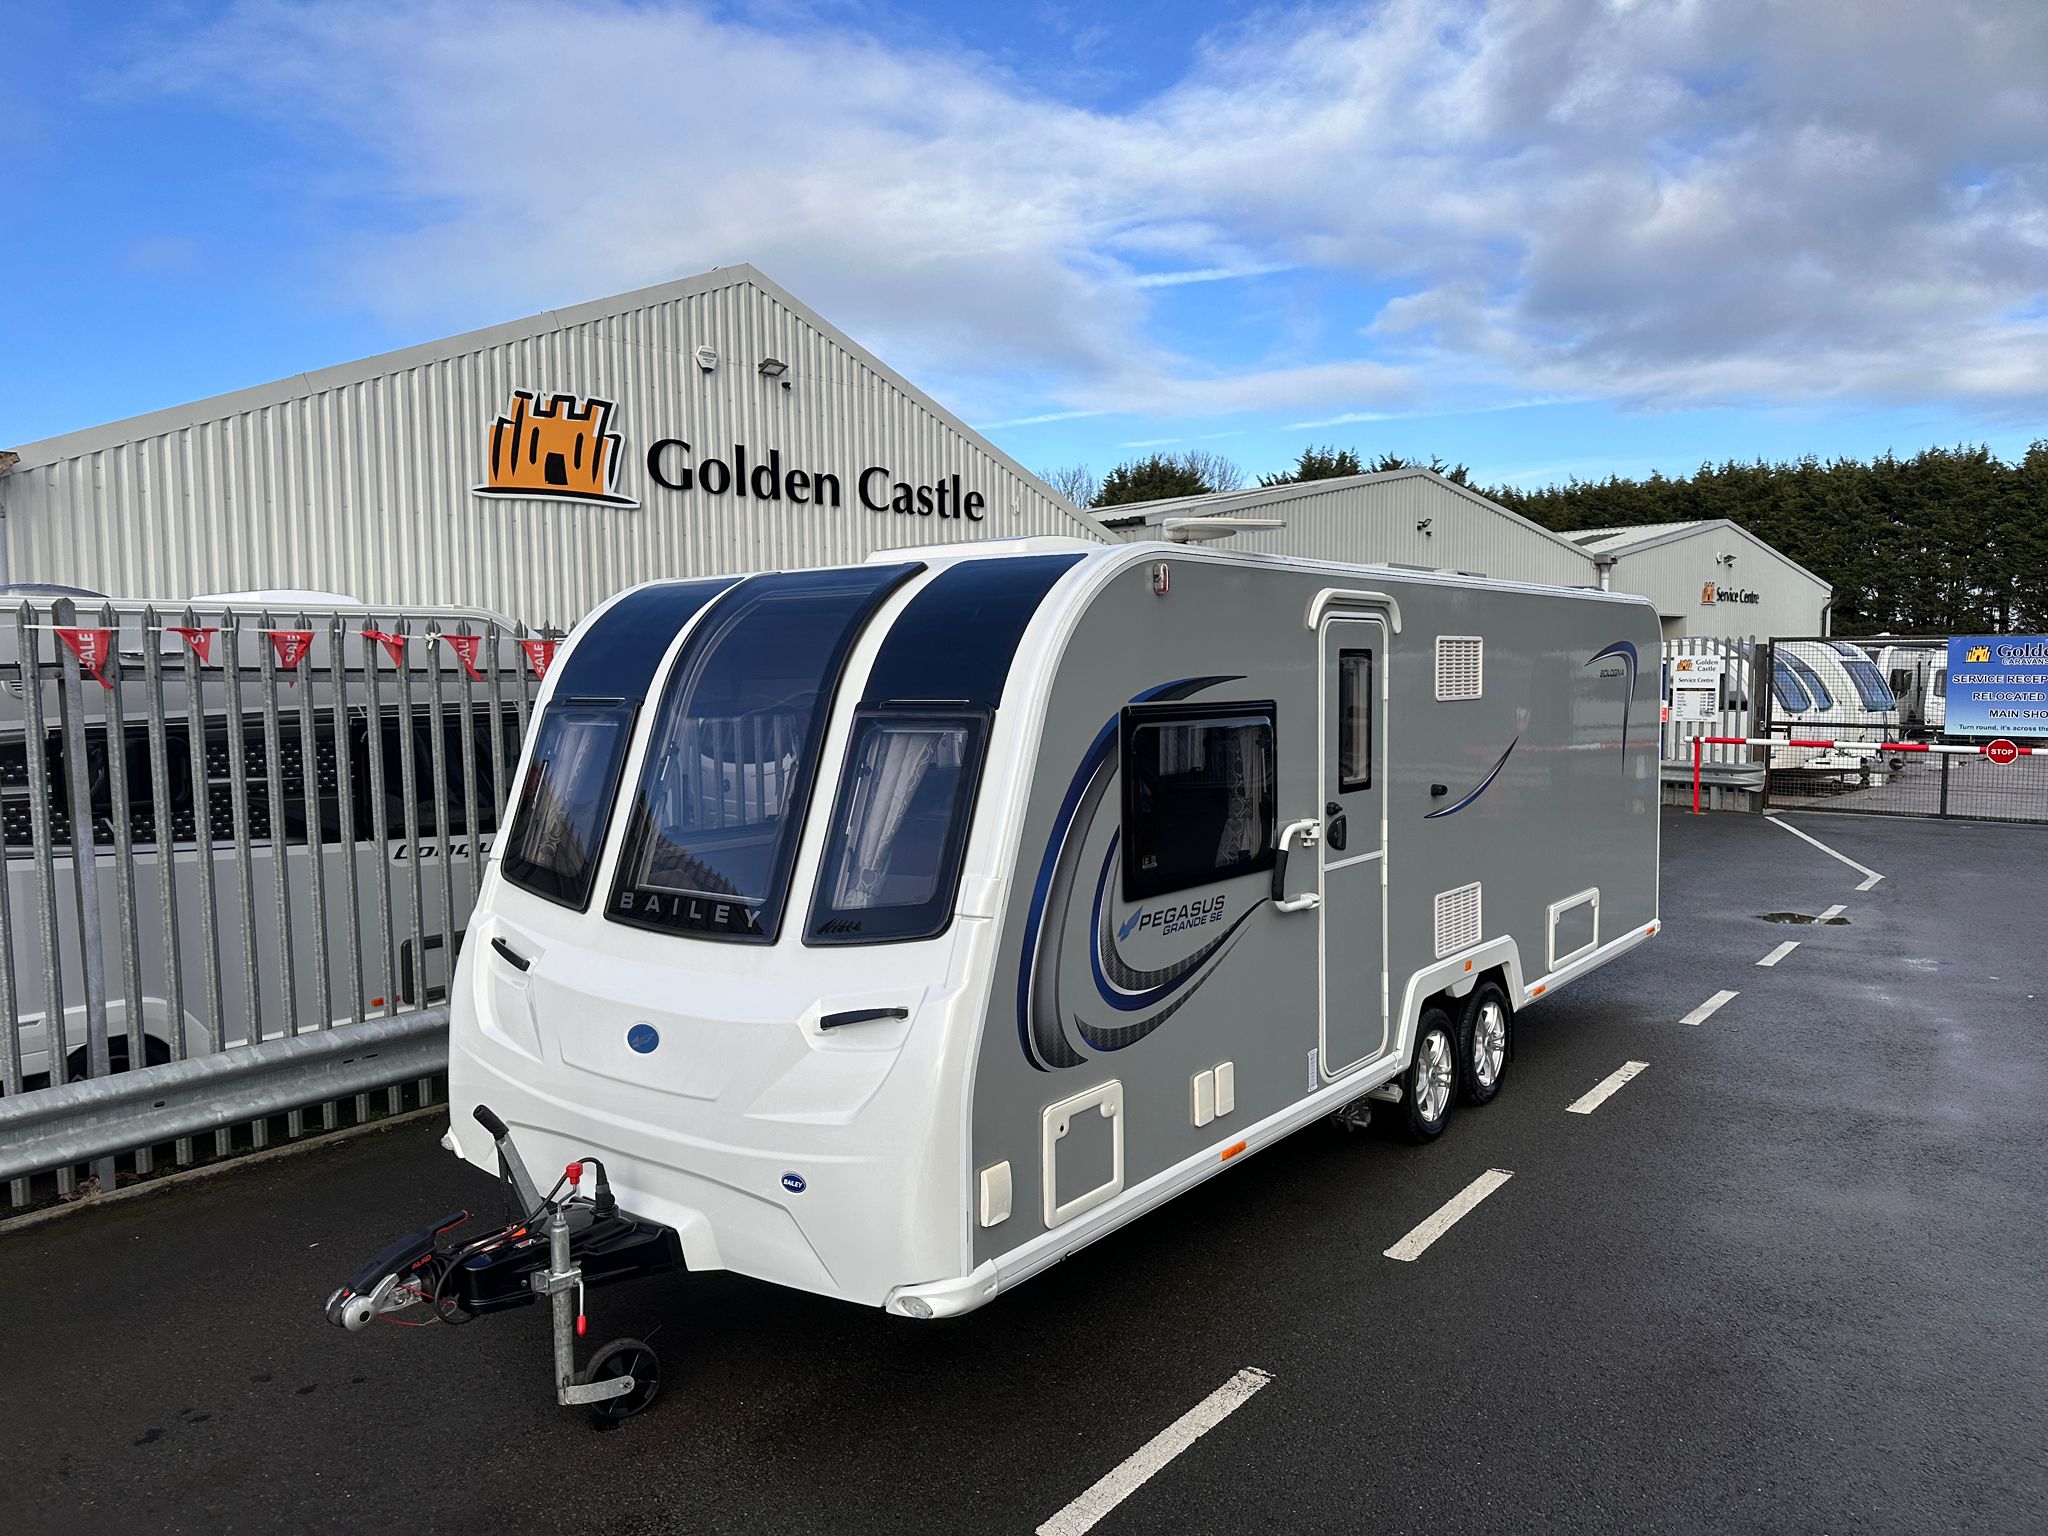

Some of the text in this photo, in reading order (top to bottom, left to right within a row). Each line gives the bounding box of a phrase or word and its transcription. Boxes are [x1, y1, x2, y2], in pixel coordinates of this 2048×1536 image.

[646, 438, 986, 522] Golden Castle
[1716, 586, 1760, 604] Service Centre
[79, 632, 96, 670] SALE
[286, 634, 301, 663] SALE
[533, 643, 544, 674] SALE
[2002, 658, 2048, 666] CARAVANS
[1600, 668, 1625, 678] BOLOGNA
[1953, 674, 2048, 684] SERVICE RECEP
[1972, 692, 2046, 701] RELOCATED
[1989, 709, 2048, 719] MAIN SHO
[1990, 748, 2014, 756] STOP
[619, 891, 761, 928] BAILEY
[1138, 895, 1226, 931] PEGASUS
[1162, 910, 1223, 936] GRANDE SE
[783, 1178, 803, 1188] BAILEY
